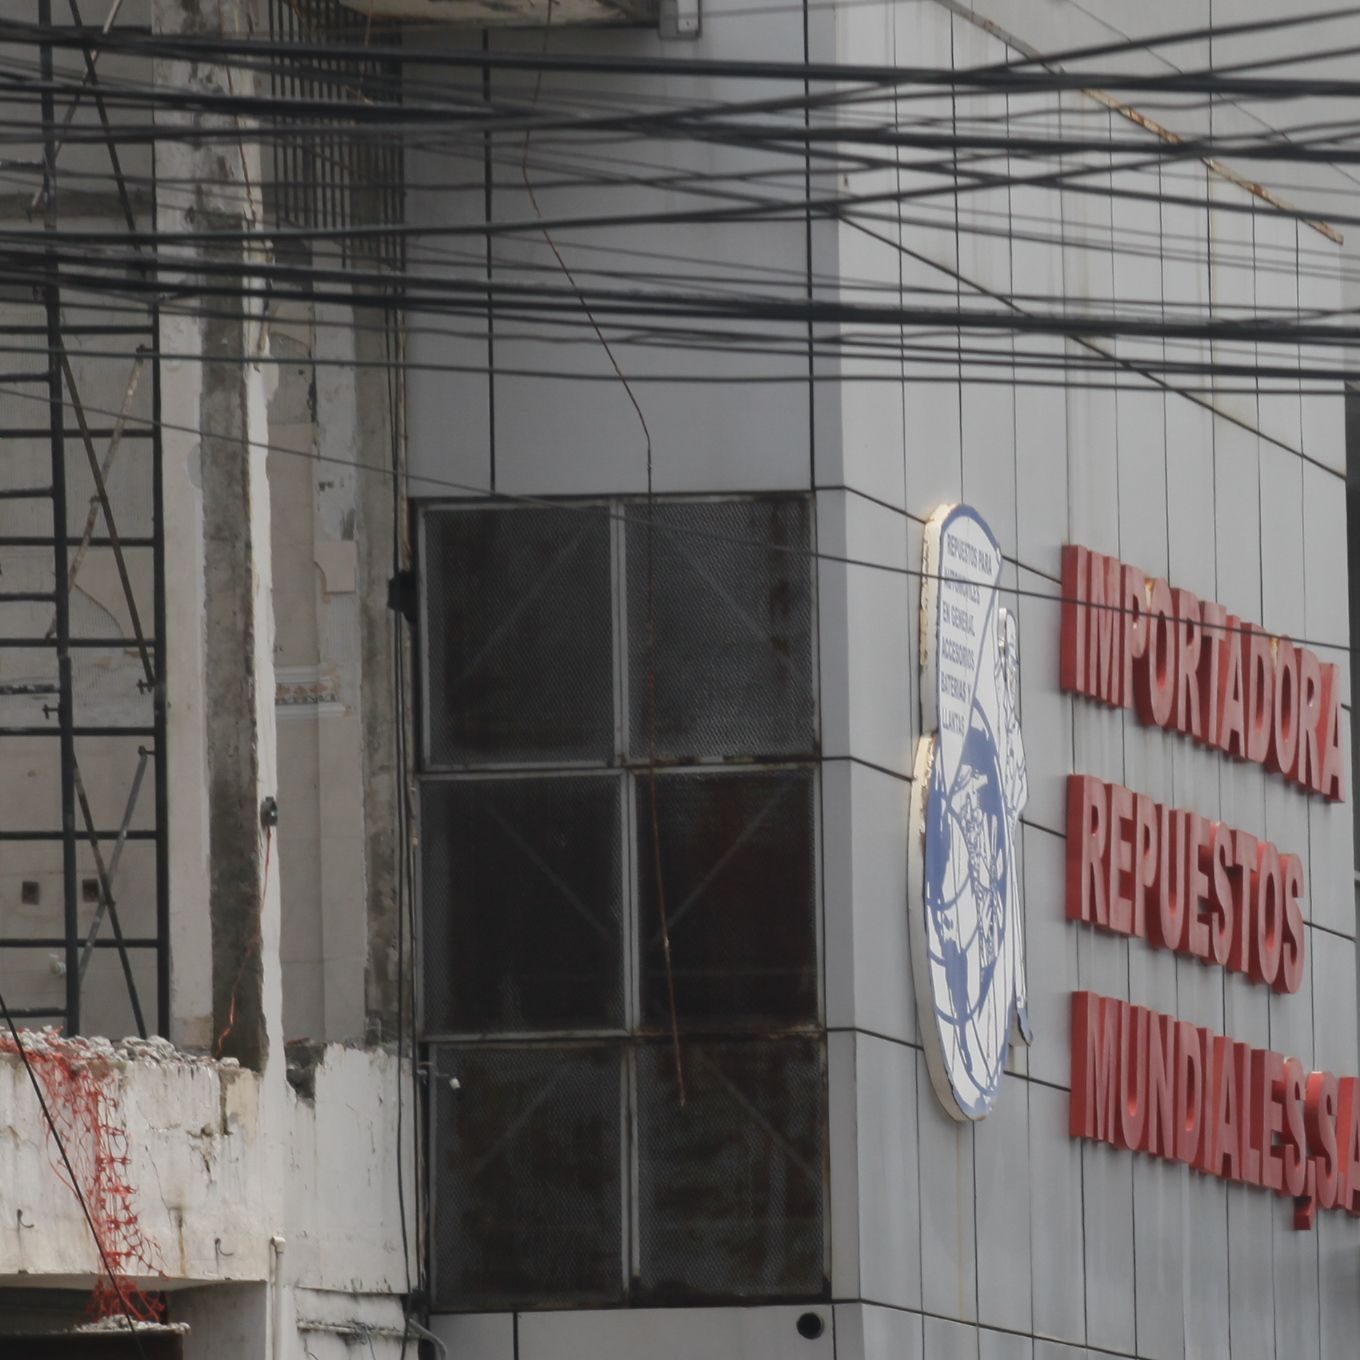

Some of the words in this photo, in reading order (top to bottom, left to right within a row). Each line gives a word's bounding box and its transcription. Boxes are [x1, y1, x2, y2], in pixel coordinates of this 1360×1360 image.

[946, 533, 978, 570] REPUESTOS
[978, 549, 993, 577] PARA
[942, 601, 951, 626] EN
[950, 606, 976, 637] GENERAL
[941, 636, 975, 672] ACCESORIOS
[940, 672, 966, 702] BATERIAS
[965, 683, 972, 706] Y
[1061, 544, 1346, 803] IMPORTADORA
[941, 707, 966, 737] LLANTAS
[1066, 773, 1304, 995] REPUESTOS
